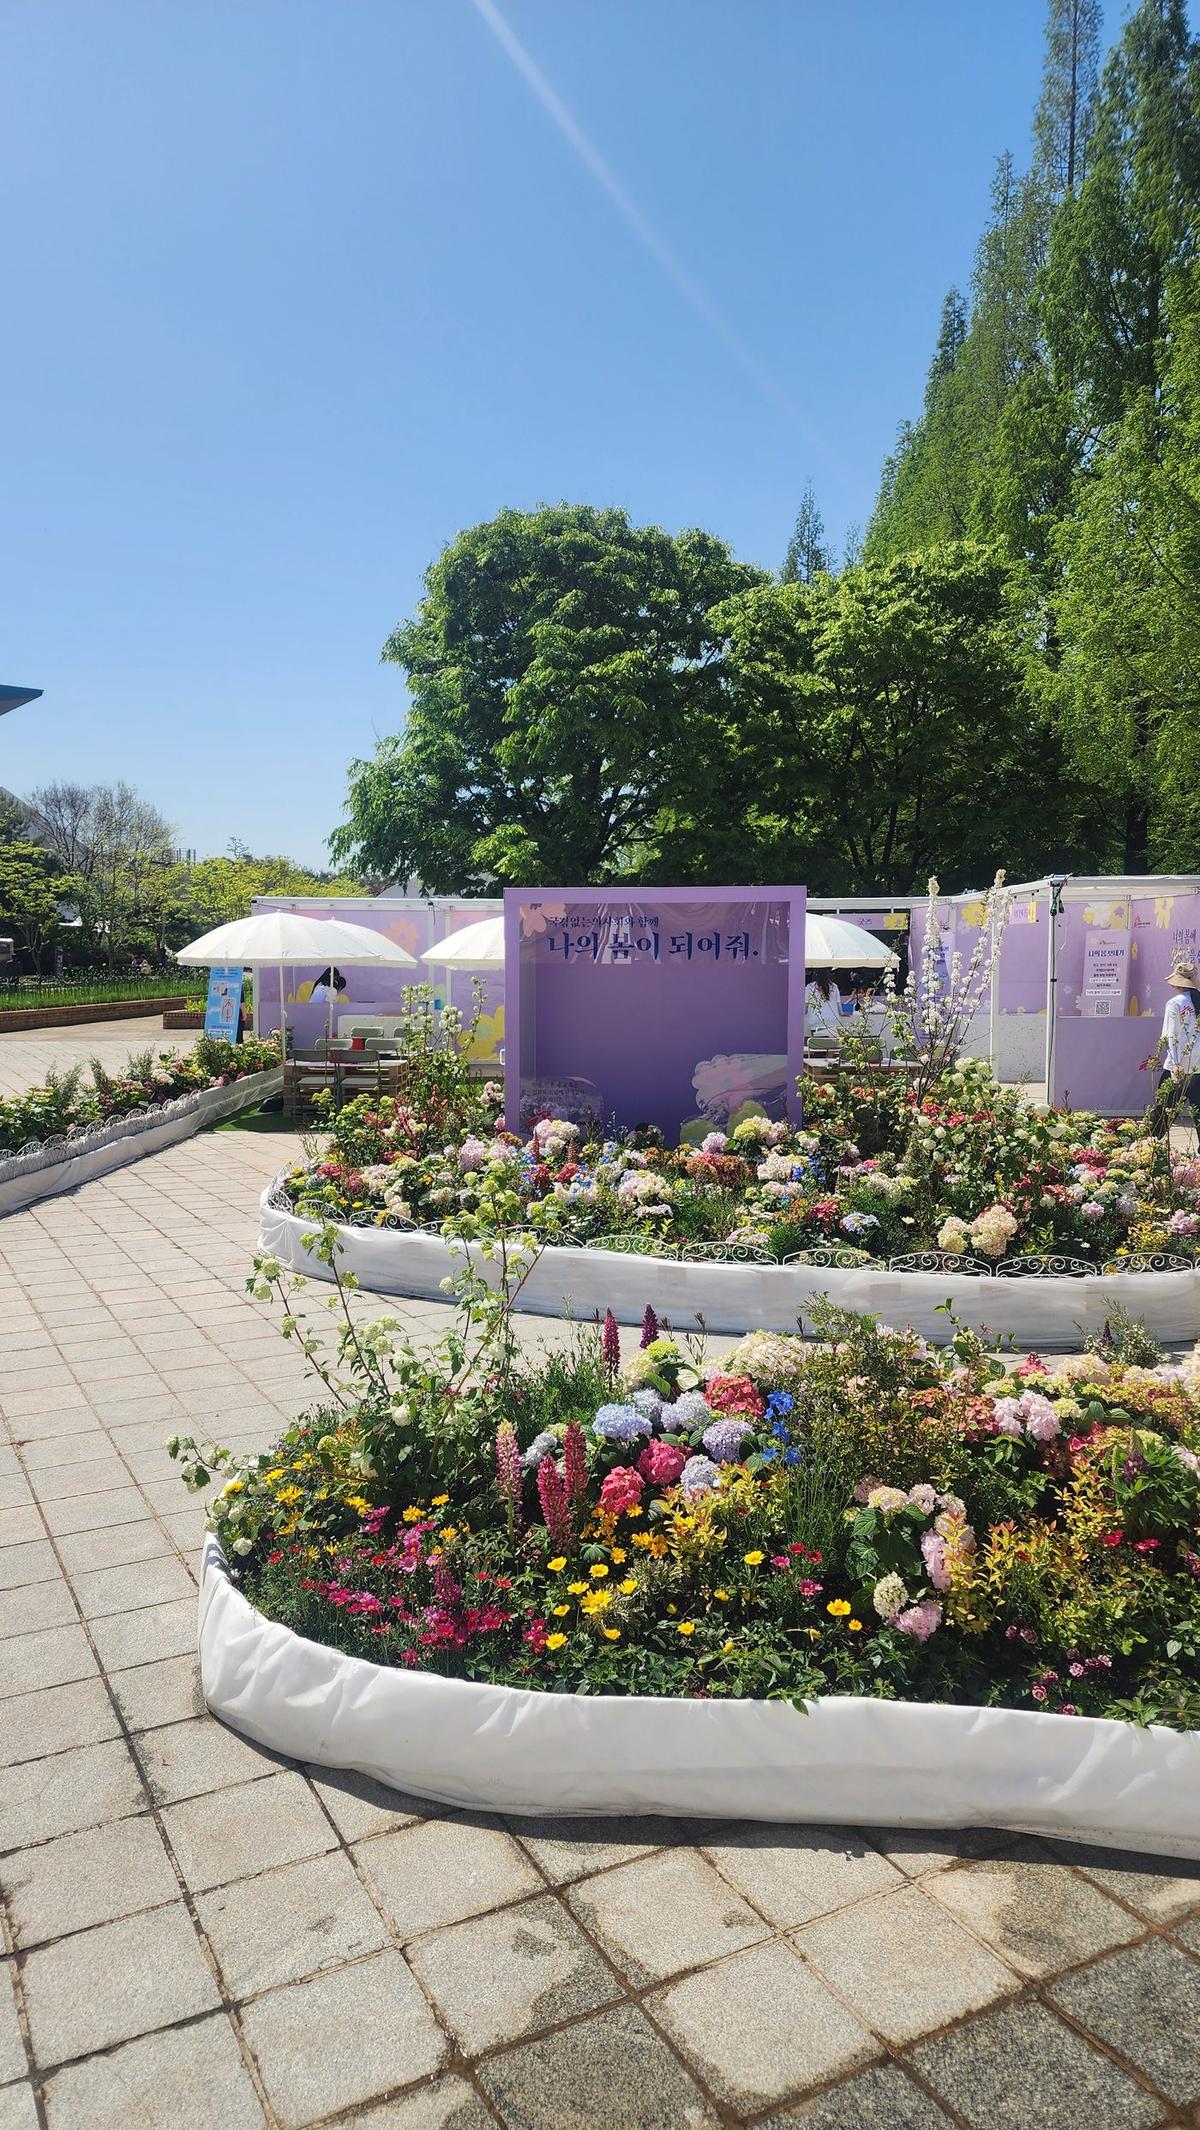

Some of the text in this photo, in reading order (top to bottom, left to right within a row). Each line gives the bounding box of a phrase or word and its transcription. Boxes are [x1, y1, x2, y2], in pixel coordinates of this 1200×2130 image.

[549, 916, 659, 928] 국경없는의사회와 함께
[548, 931, 759, 961] 나의 봄이 되어줘.
